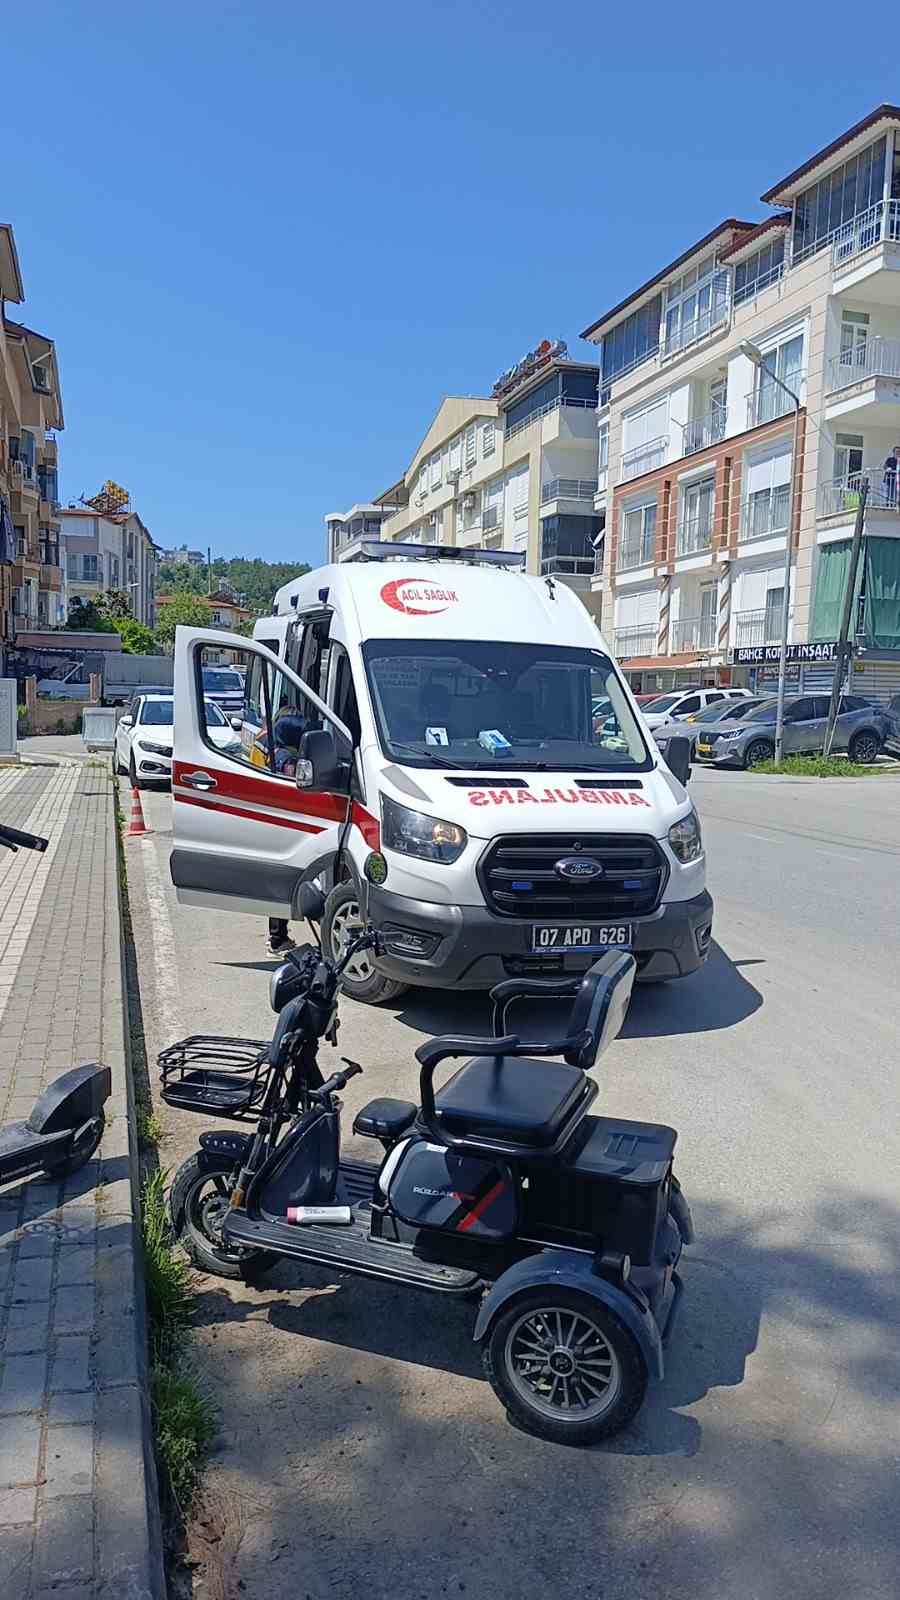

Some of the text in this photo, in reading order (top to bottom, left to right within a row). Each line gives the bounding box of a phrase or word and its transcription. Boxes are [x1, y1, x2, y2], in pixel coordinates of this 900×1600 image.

[540, 927, 626, 946] 07 APD 626
